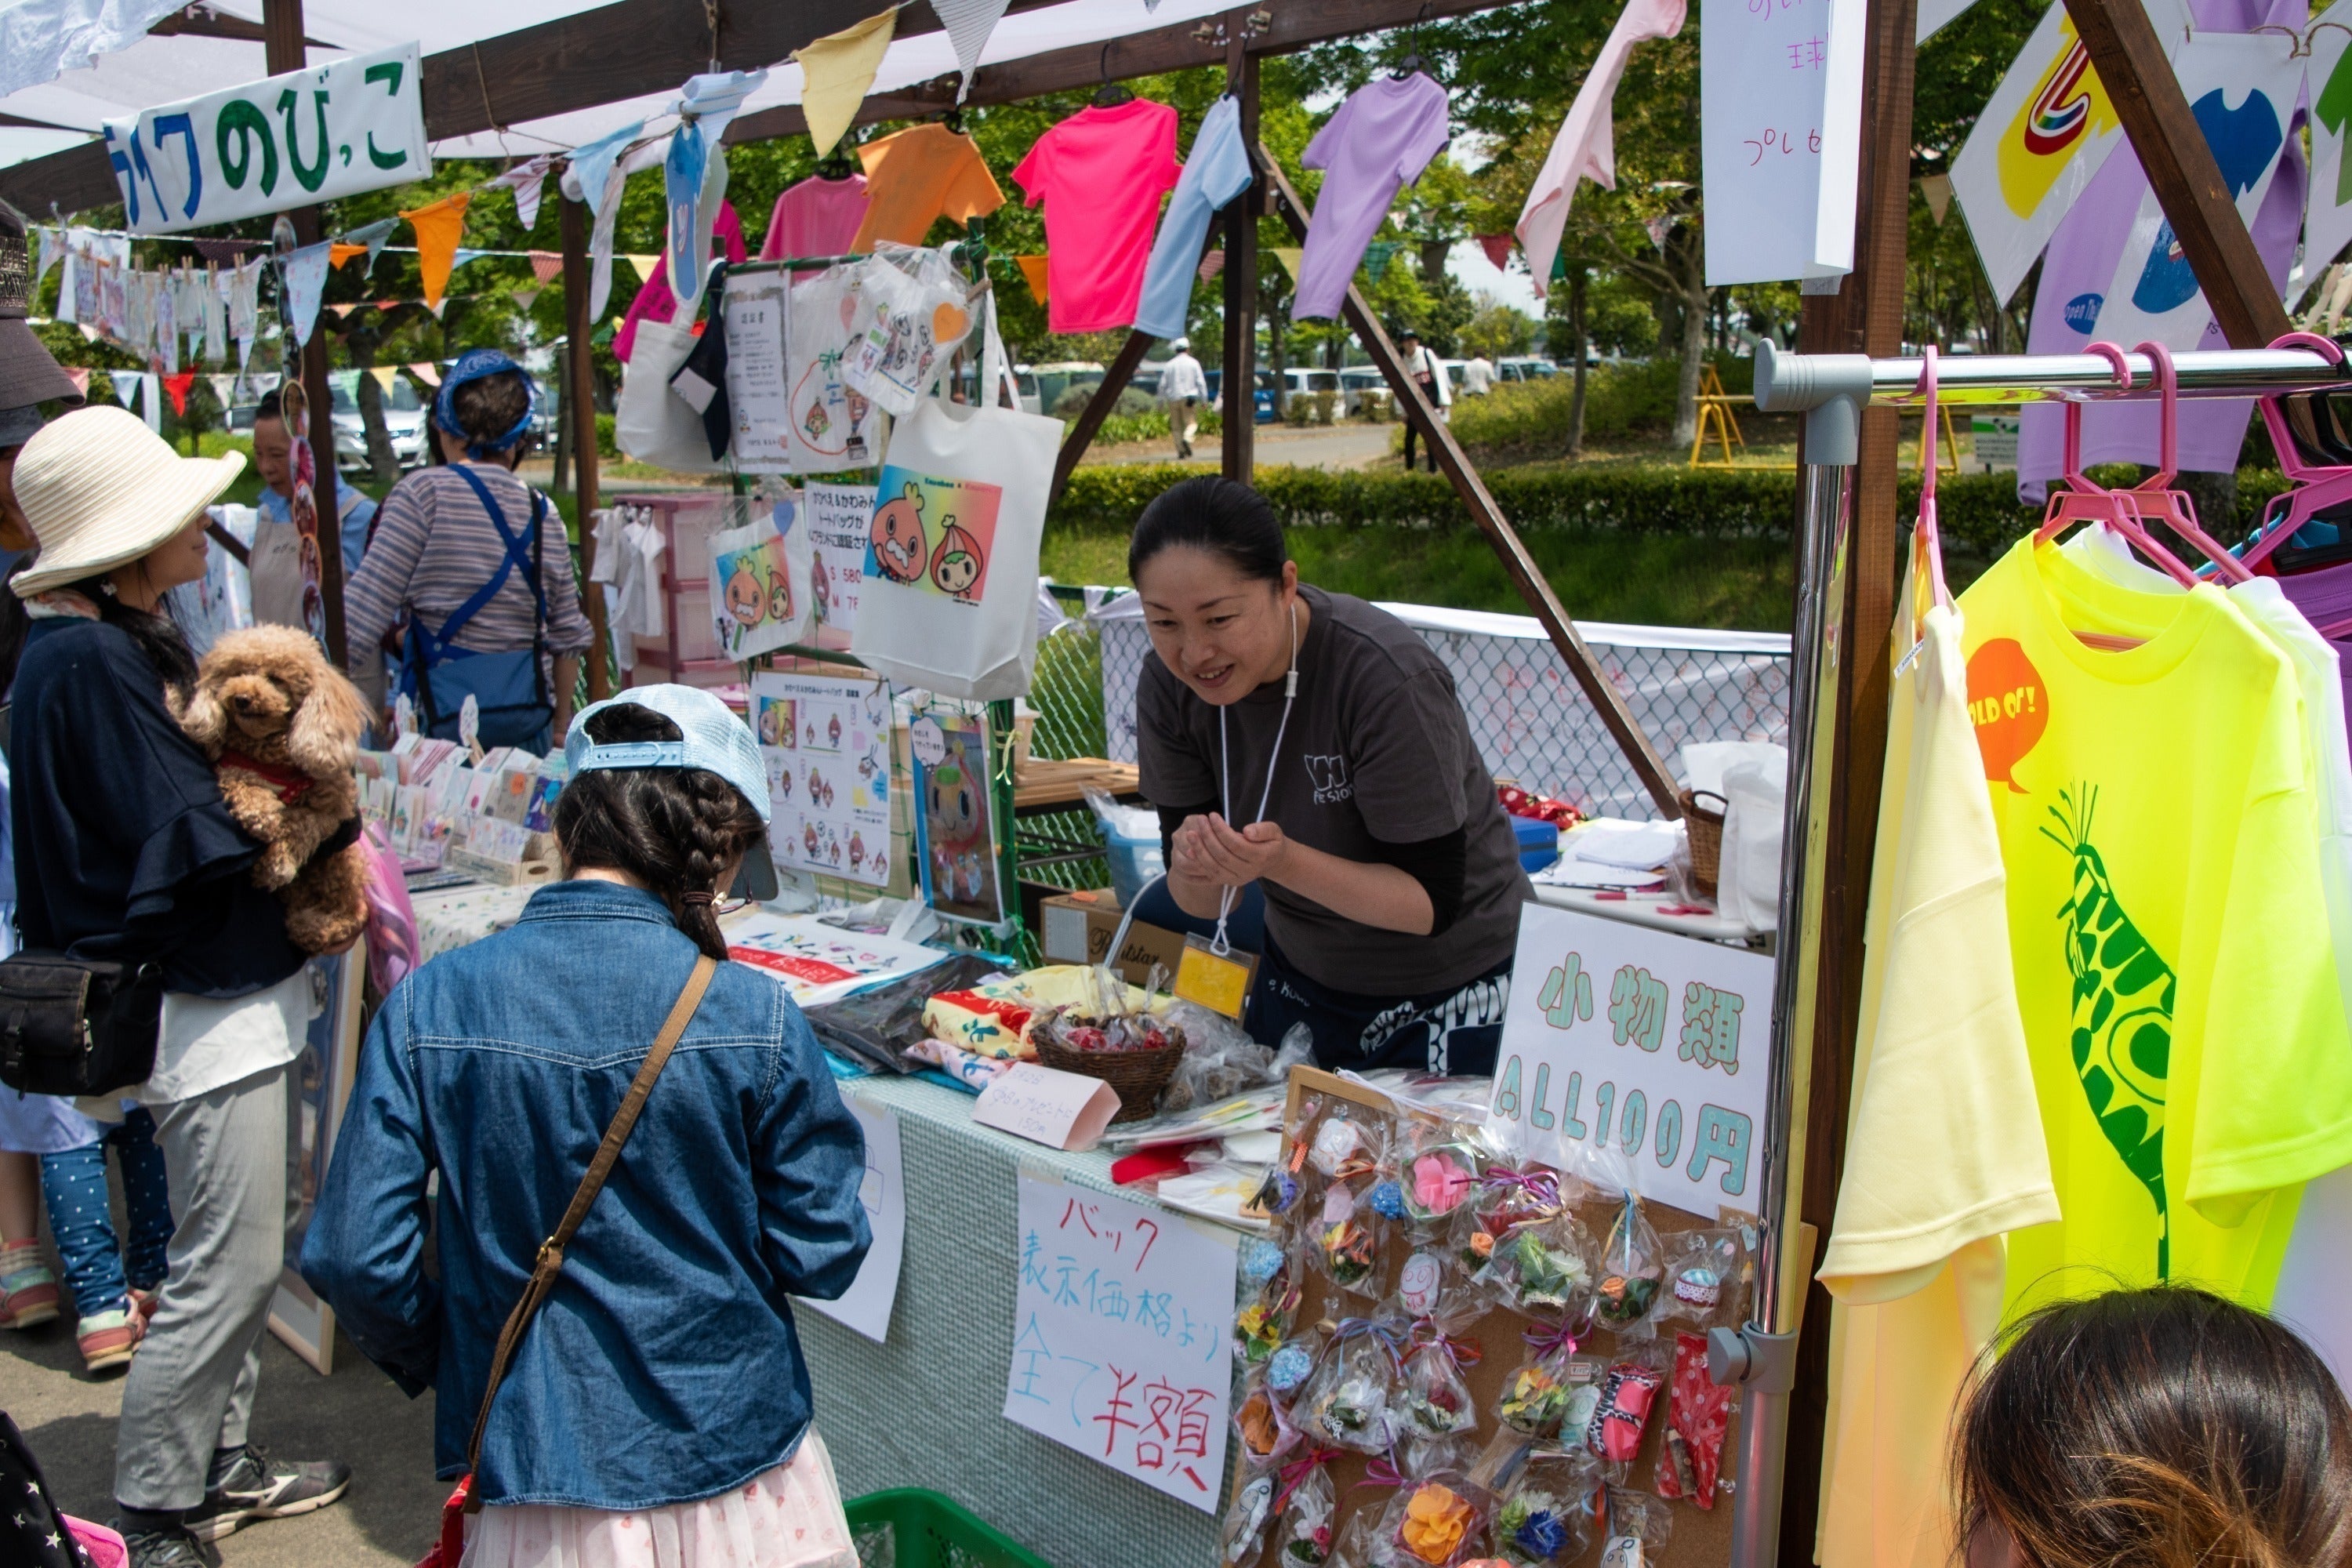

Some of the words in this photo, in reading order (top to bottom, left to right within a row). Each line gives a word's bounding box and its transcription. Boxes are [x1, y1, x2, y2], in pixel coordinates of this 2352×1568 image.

[1537, 951, 1744, 1076] 小物類
[1020, 1229, 1218, 1363] 表示価格より
